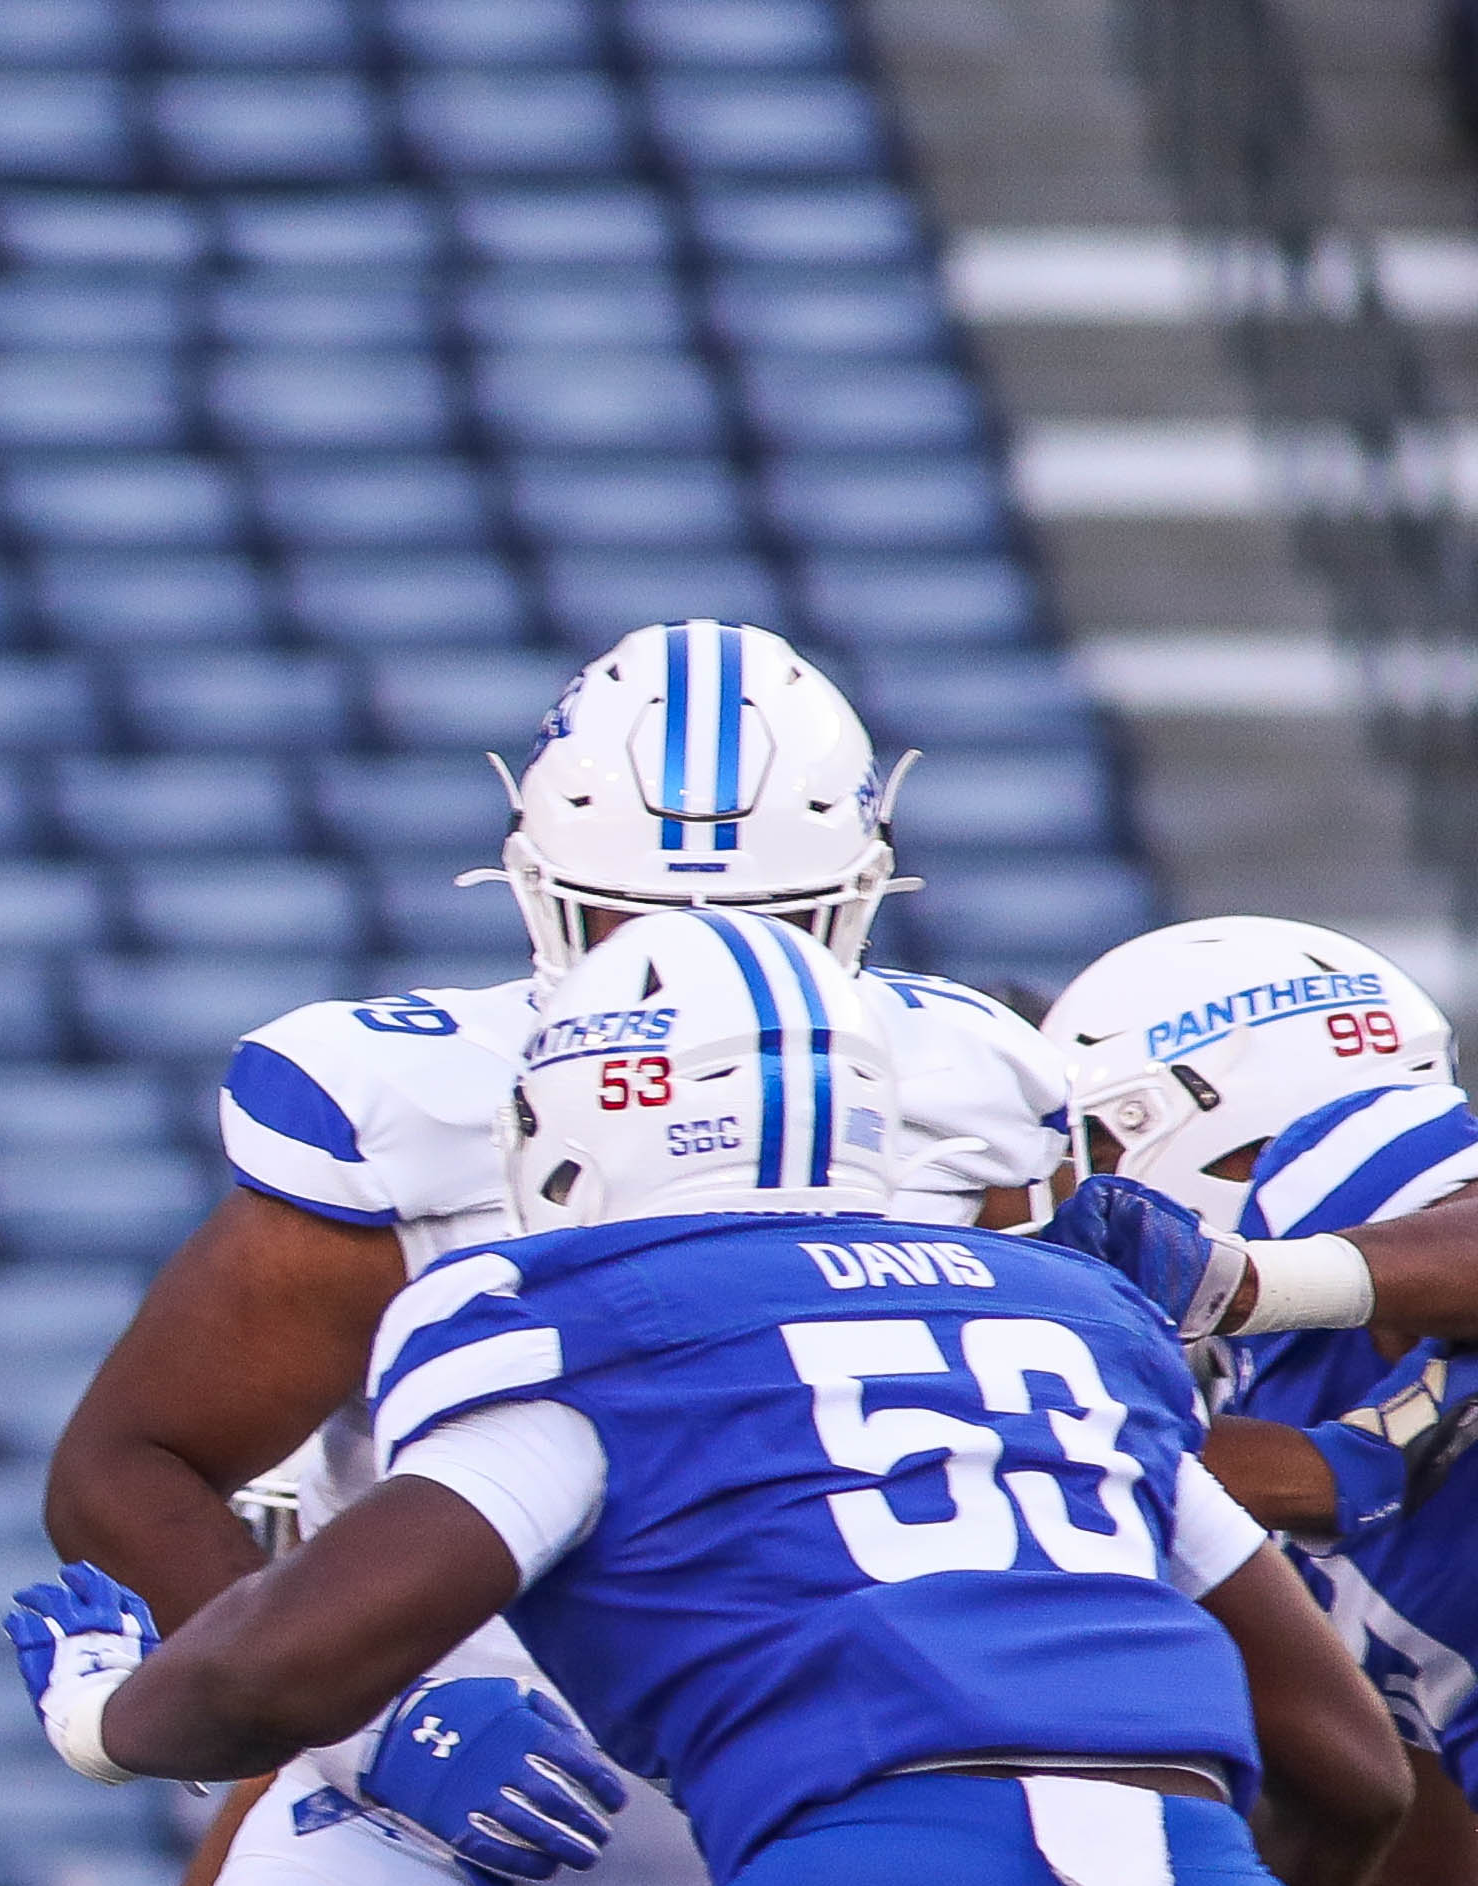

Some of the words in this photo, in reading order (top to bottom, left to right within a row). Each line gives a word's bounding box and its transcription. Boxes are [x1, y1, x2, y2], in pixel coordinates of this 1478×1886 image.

[1146, 973, 1386, 1058] PANTHERS
[1327, 1010, 1401, 1057] 99
[598, 1056, 672, 1111] 53
[668, 1115, 741, 1157] SBC
[797, 1241, 996, 1290] DAVIS
[778, 1318, 1158, 1584] 53
